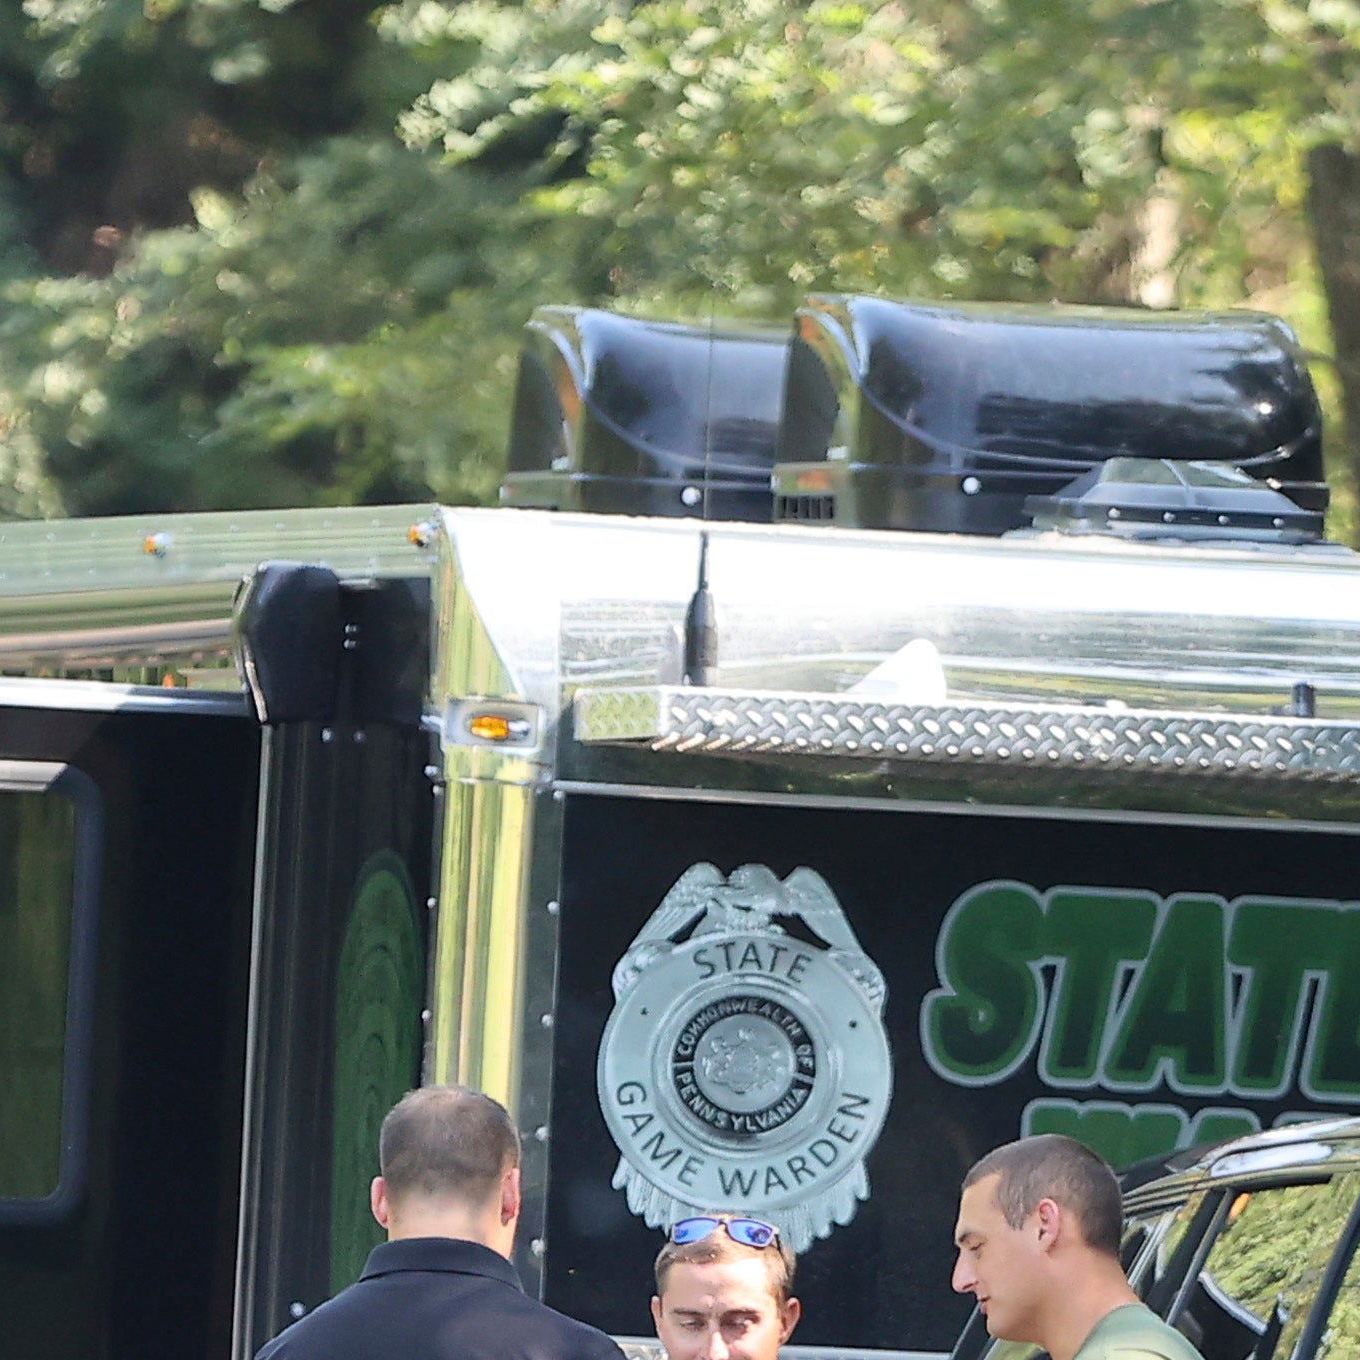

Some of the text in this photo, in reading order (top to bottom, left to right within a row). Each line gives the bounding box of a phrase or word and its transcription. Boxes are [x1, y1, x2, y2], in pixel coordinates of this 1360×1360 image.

[692, 940, 813, 984] STATE
[676, 998, 815, 1071] COMMONWEALTH OF
[675, 1071, 807, 1132] PENNSYLVANIA
[616, 1081, 870, 1198] GAME WARDEN
